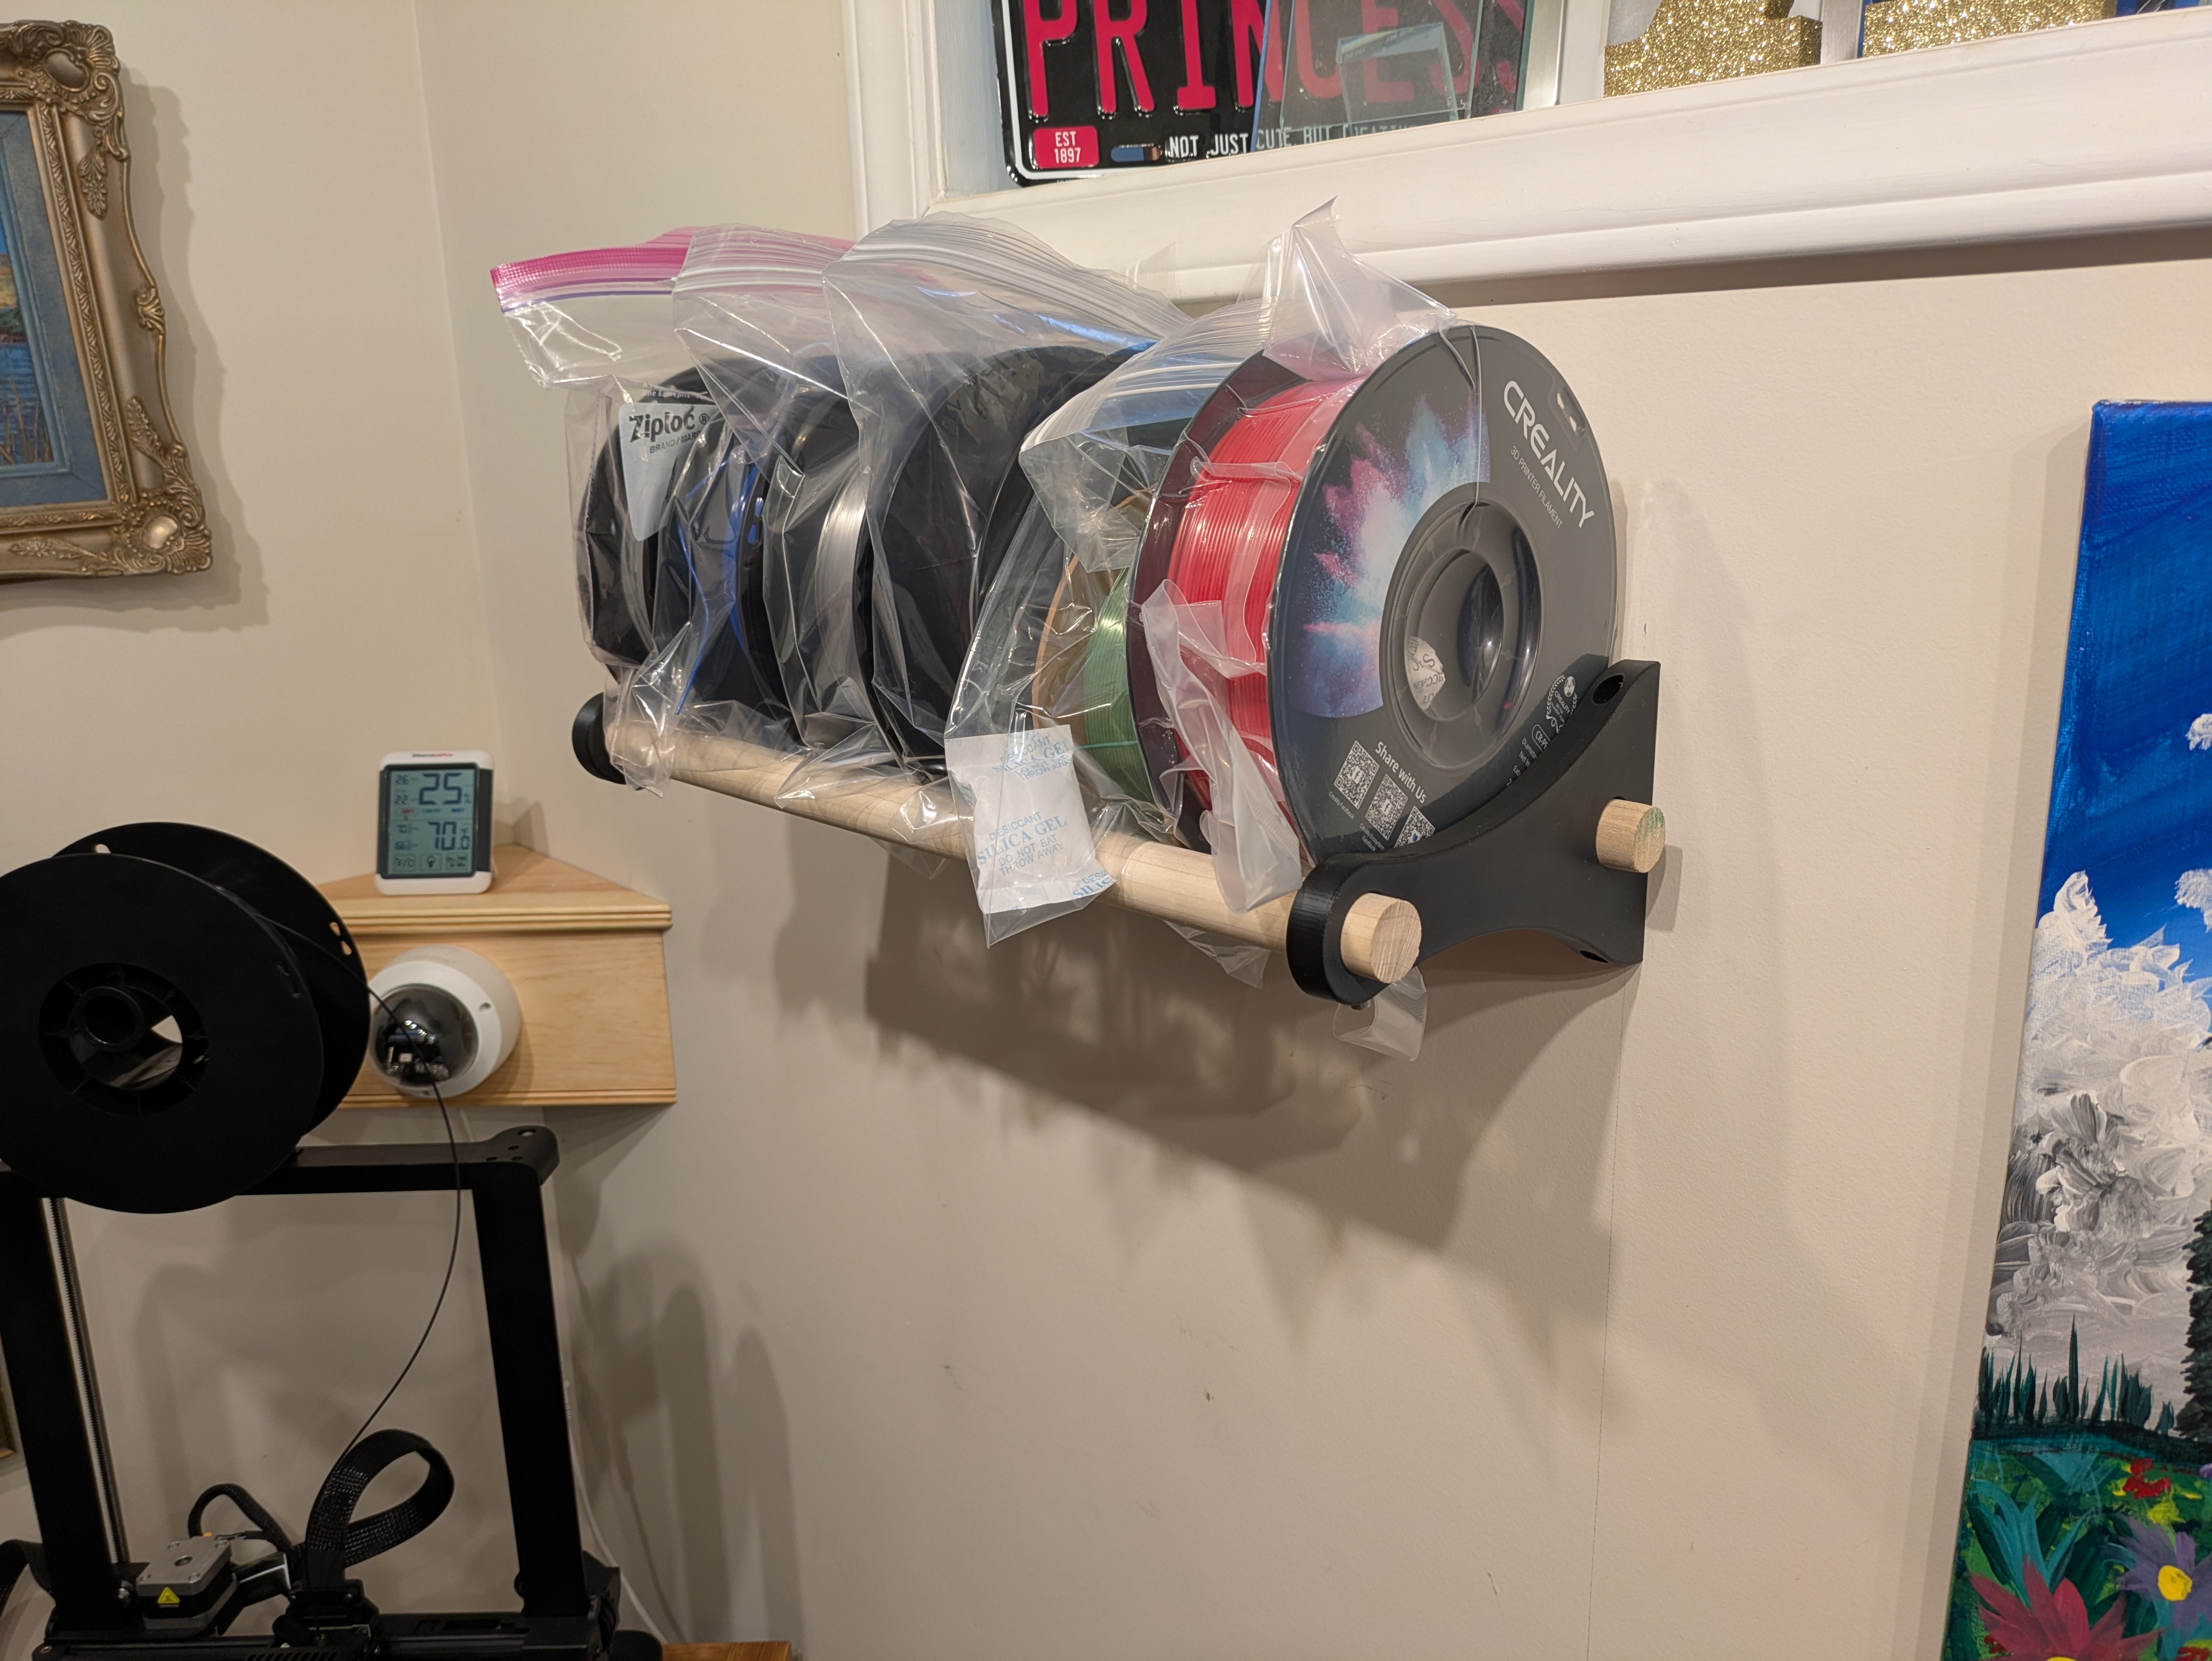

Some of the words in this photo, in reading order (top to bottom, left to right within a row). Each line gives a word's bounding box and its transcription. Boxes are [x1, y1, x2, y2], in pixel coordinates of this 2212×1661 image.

[1024, 0, 1524, 116] PRINCES
[1054, 147, 1081, 164] 1897
[1055, 131, 1076, 147] EST
[1169, 135, 1199, 158] NOT
[1210, 133, 1249, 156] JUST
[1304, 125, 1331, 144] BUT
[1504, 381, 1595, 528] CREALITY
[1510, 445, 1519, 460] 3D
[1518, 457, 1540, 494] PRINTER
[1538, 490, 1563, 529] FILAMENT
[1555, 690, 1571, 714] CREALITY
[1018, 766, 1051, 780] THROW
[1375, 741, 1399, 773] Share
[1398, 768, 1416, 793] with
[1415, 786, 1427, 804] Us
[1519, 751, 1527, 763] Net
[420, 772, 463, 805] 25
[1328, 791, 1341, 807] Creality
[1339, 802, 1355, 820] Facebook
[428, 821, 470, 850] 70.0
[977, 830, 1033, 865] SILICA
[1034, 816, 1067, 835] GEL
[989, 811, 1042, 842] DESICCANT
[998, 854, 1013, 867] DO
[1016, 842, 1036, 858] NOT
[1040, 834, 1058, 848] EAT
[999, 854, 1034, 876] THROW
[1038, 842, 1062, 860] AWAY
